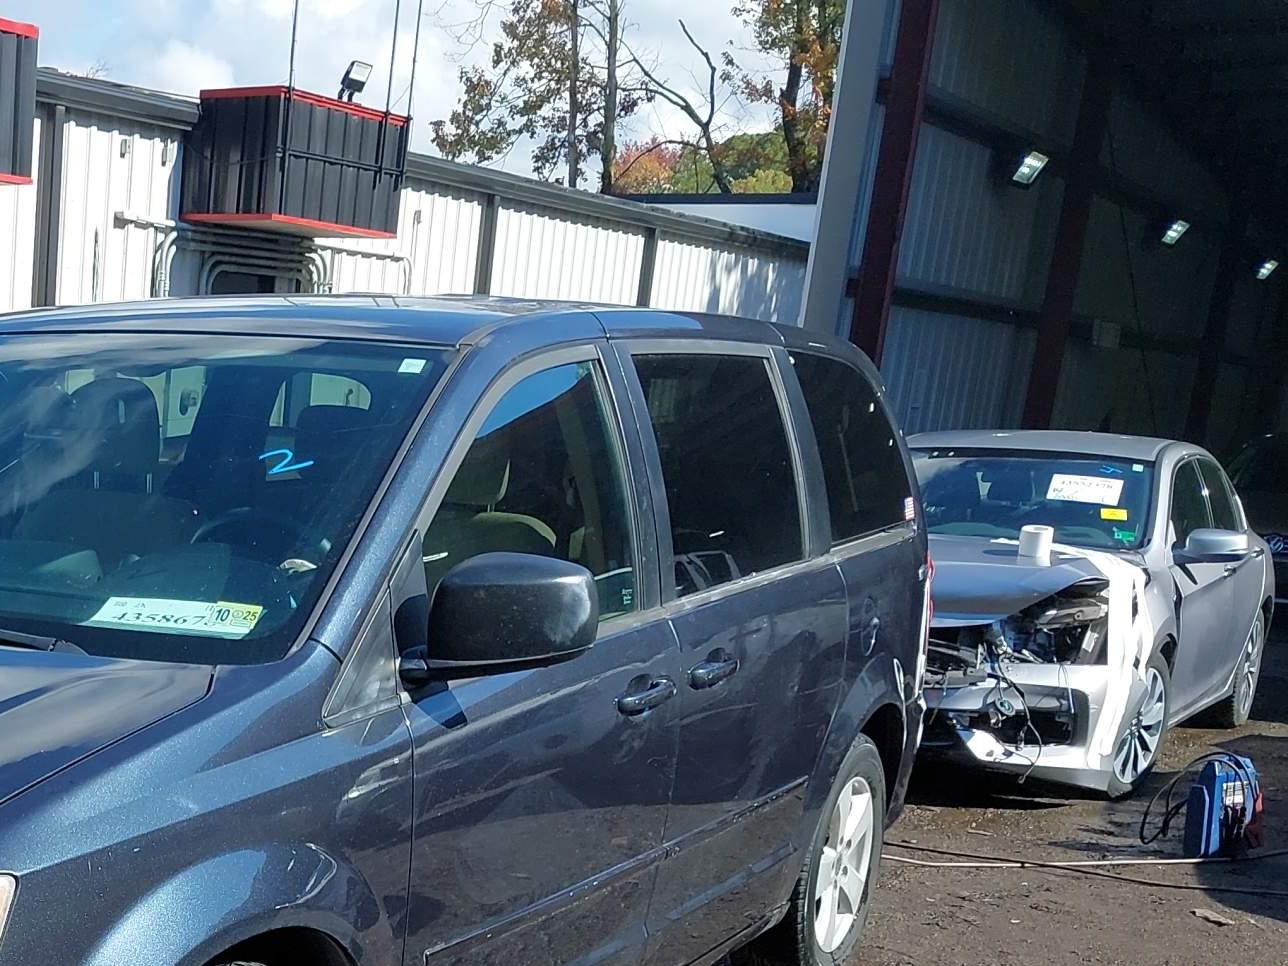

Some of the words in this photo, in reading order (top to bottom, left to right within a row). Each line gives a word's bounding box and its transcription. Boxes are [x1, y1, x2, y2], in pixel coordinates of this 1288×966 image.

[258, 447, 315, 476] 2
[215, 607, 231, 622] 10
[242, 610, 259, 622] 25
